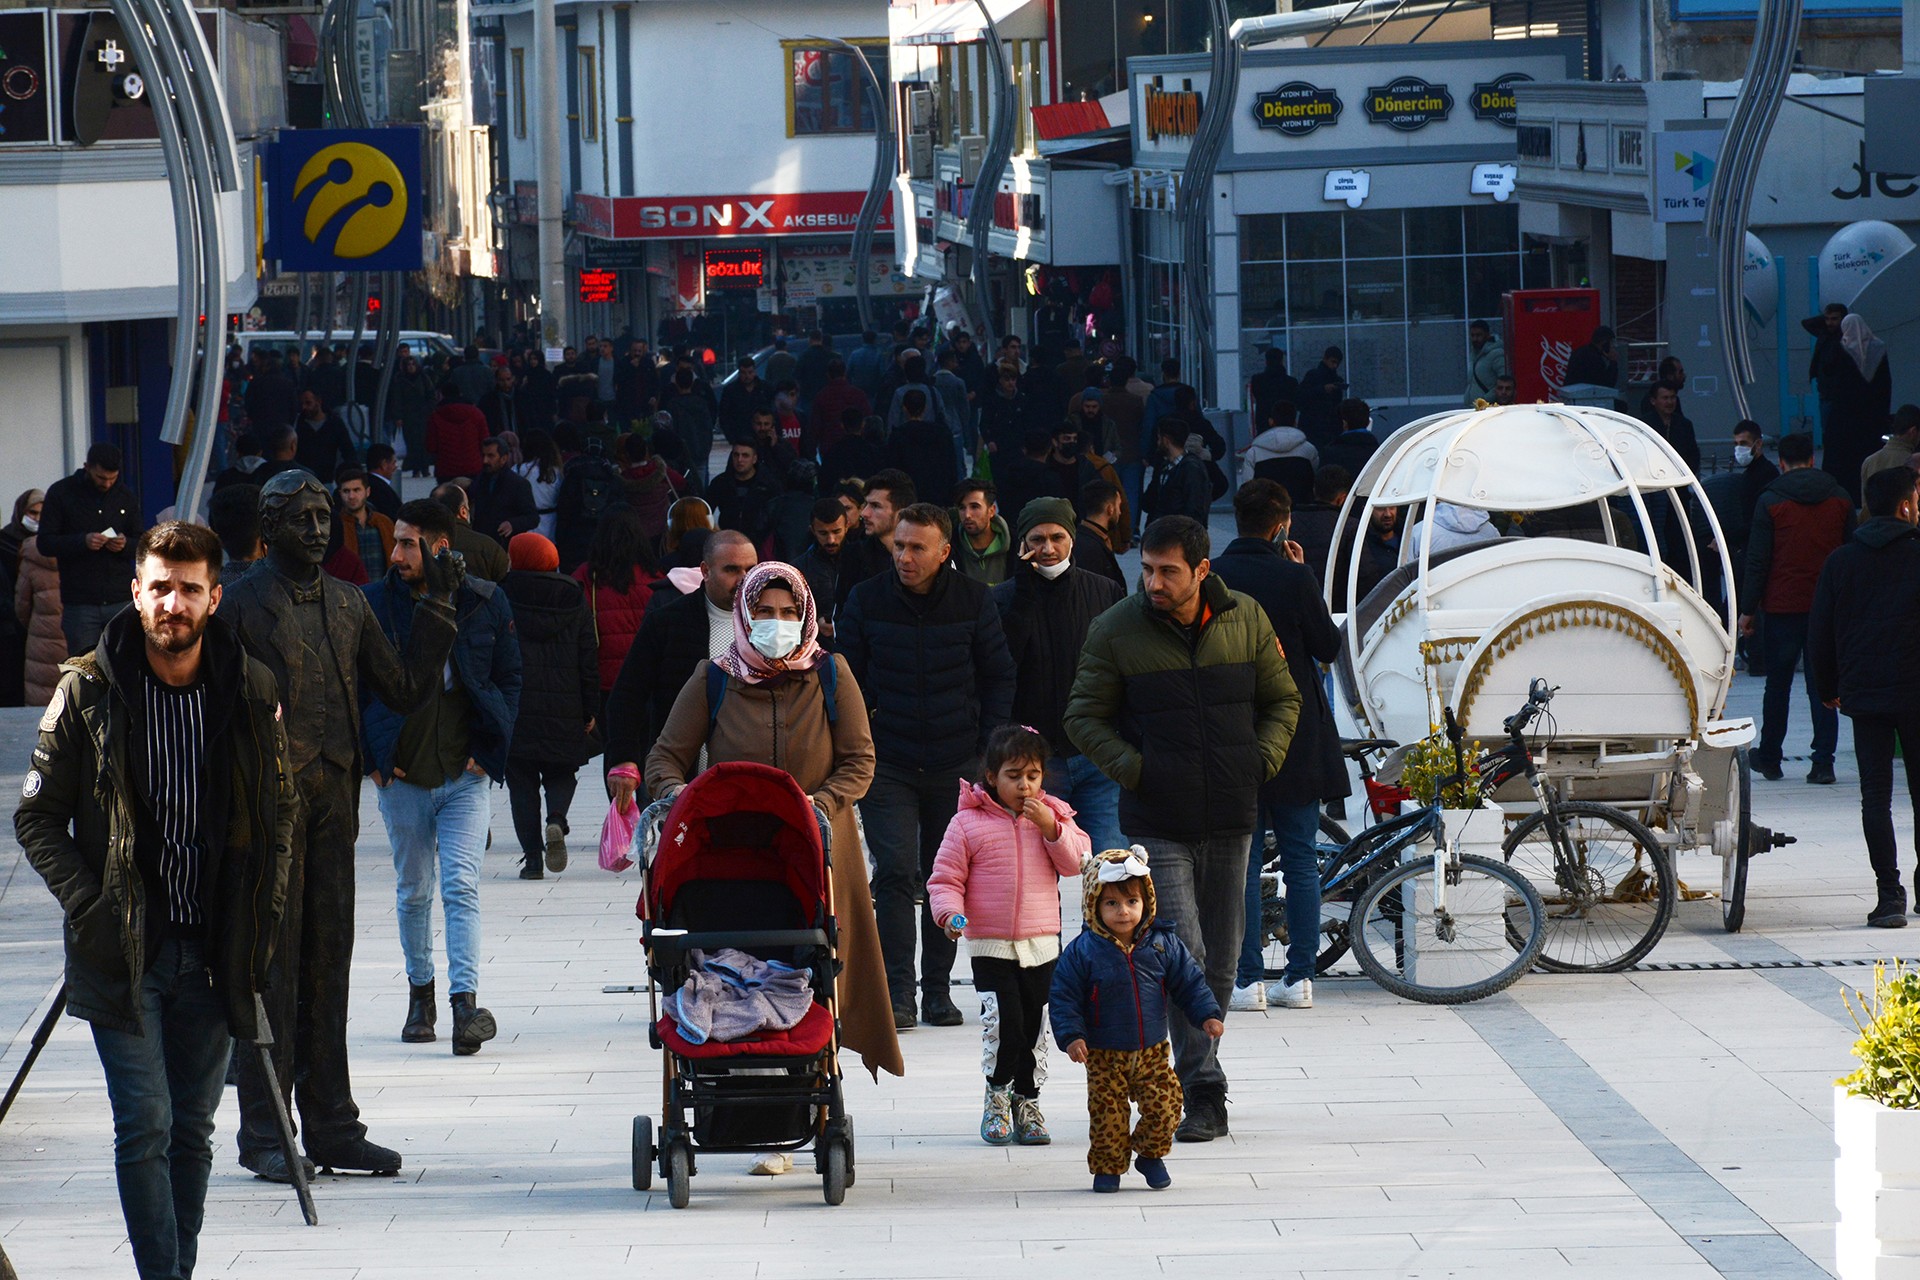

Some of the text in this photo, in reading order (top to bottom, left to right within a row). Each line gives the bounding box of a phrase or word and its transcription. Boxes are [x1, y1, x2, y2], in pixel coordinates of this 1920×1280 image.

[1280, 89, 1314, 98] AYDIN BEY
[1411, 85, 1425, 93] BEY
[1263, 99, 1332, 118] Dönercim
[1374, 95, 1443, 112] Dönercim
[1281, 119, 1316, 128] AYDIN BEY
[1392, 114, 1426, 123] AYDIN BEY
[1618, 130, 1642, 166] BÜFE
[1663, 198, 1690, 209] Türk
[783, 213, 859, 227] AKSESUA
[1833, 252, 1852, 262] Türk
[706, 261, 763, 277] GÖZLÜK
[1834, 259, 1870, 271] Telekom
